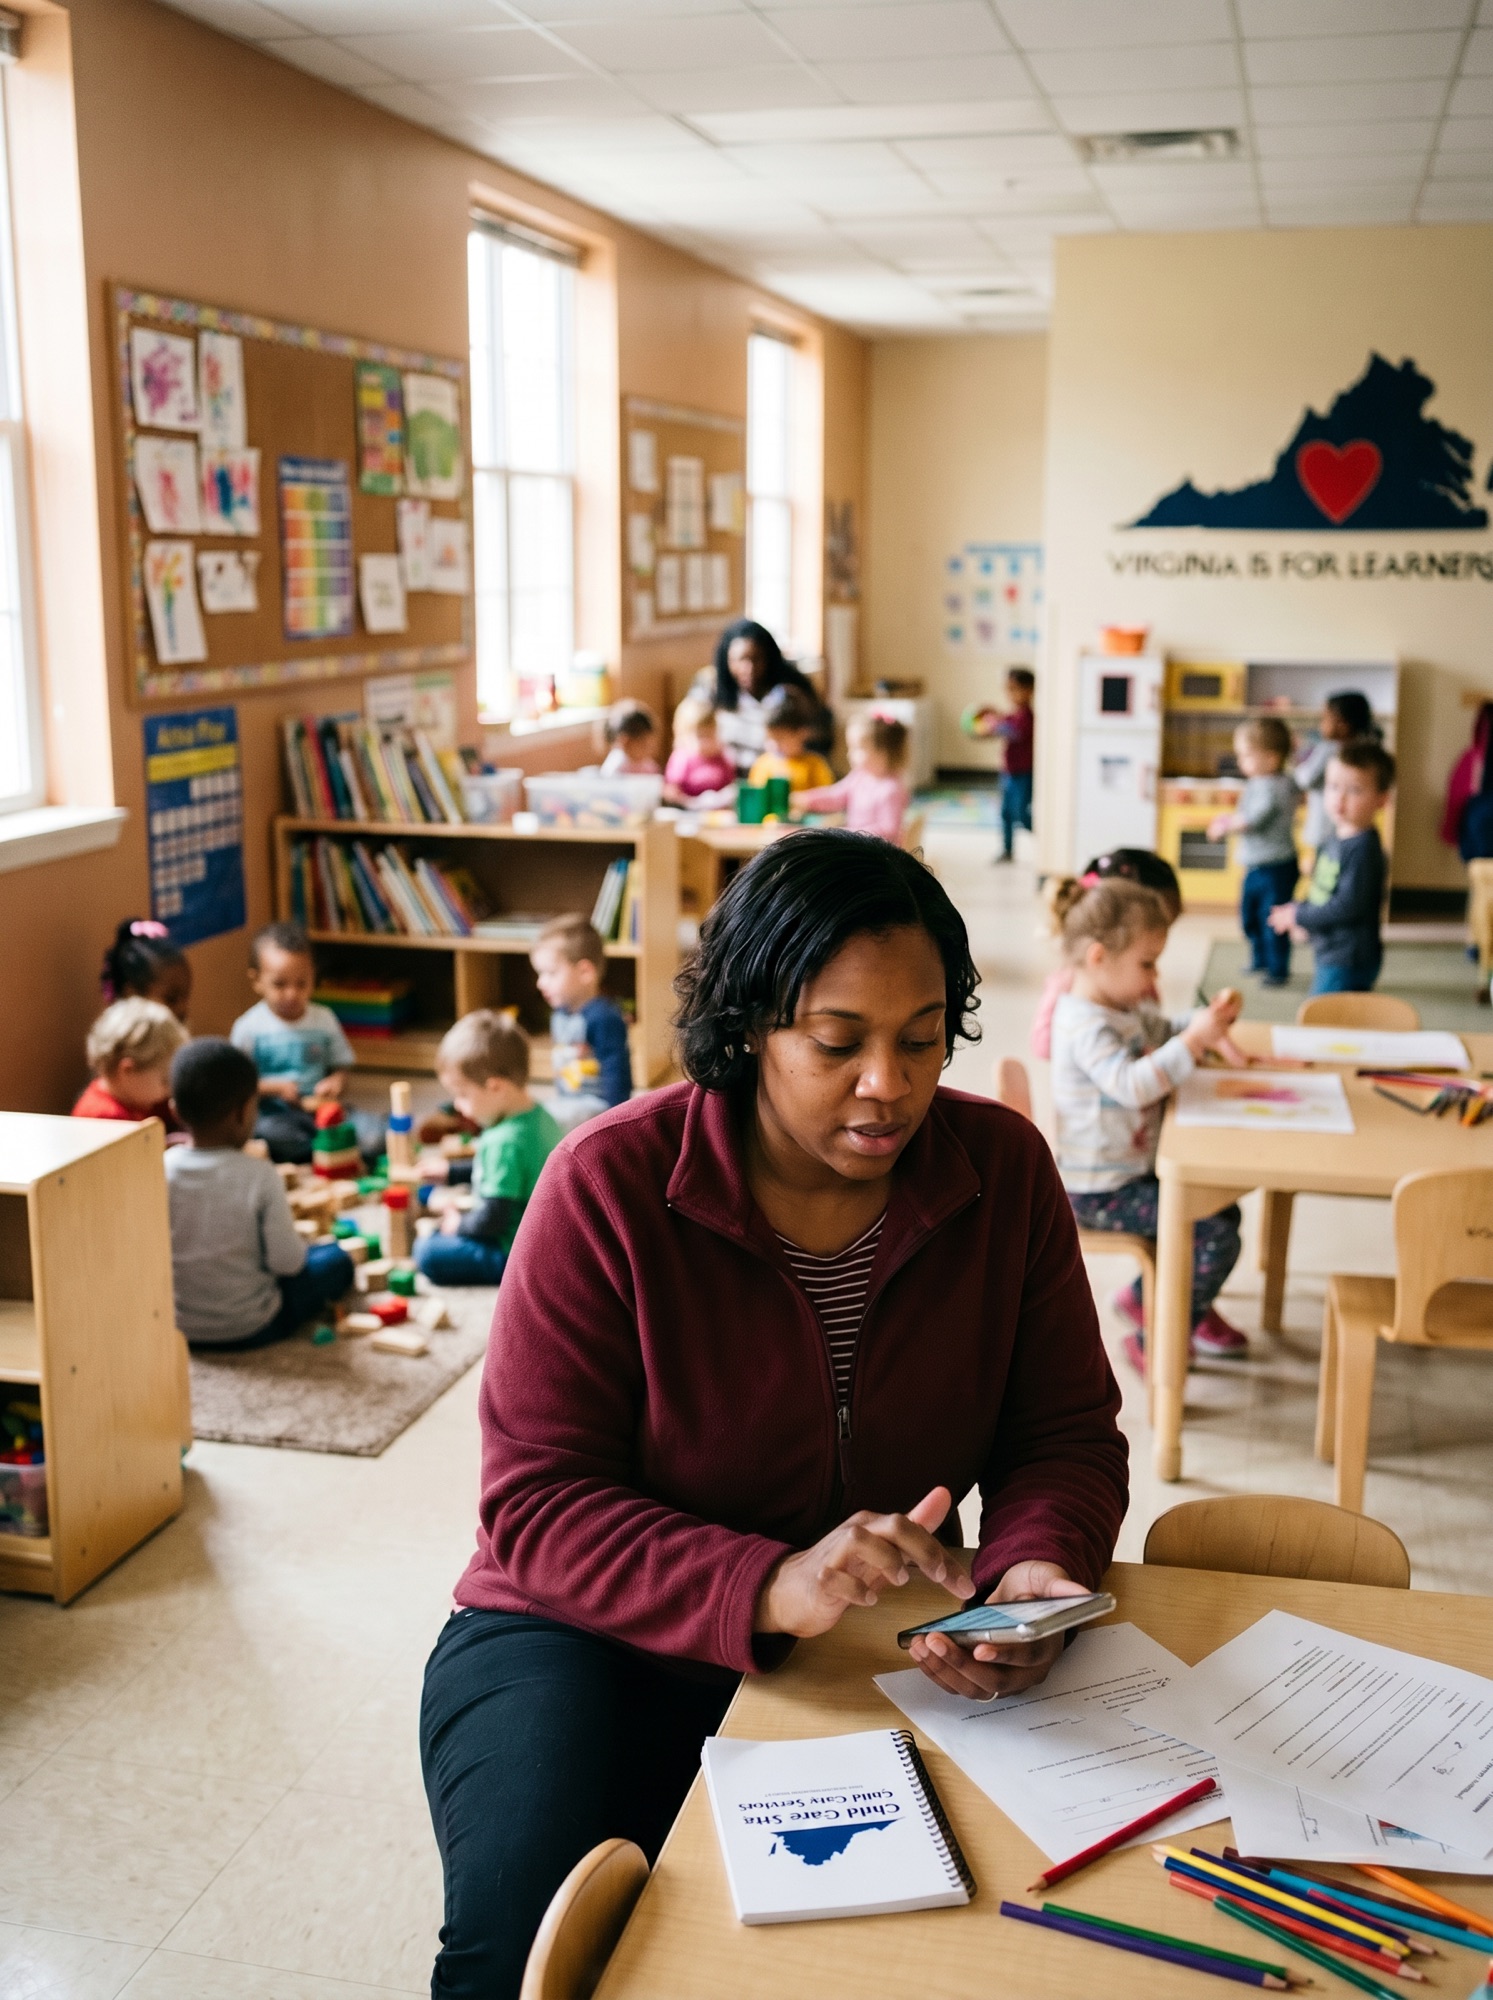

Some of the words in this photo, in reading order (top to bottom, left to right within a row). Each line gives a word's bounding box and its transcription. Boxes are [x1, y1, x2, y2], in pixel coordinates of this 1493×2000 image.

[1107, 551, 1241, 577] VIRGINIA
[1250, 551, 1272, 578] IS
[1279, 552, 1341, 579] FOR
[790, 1809, 840, 1820] Care
